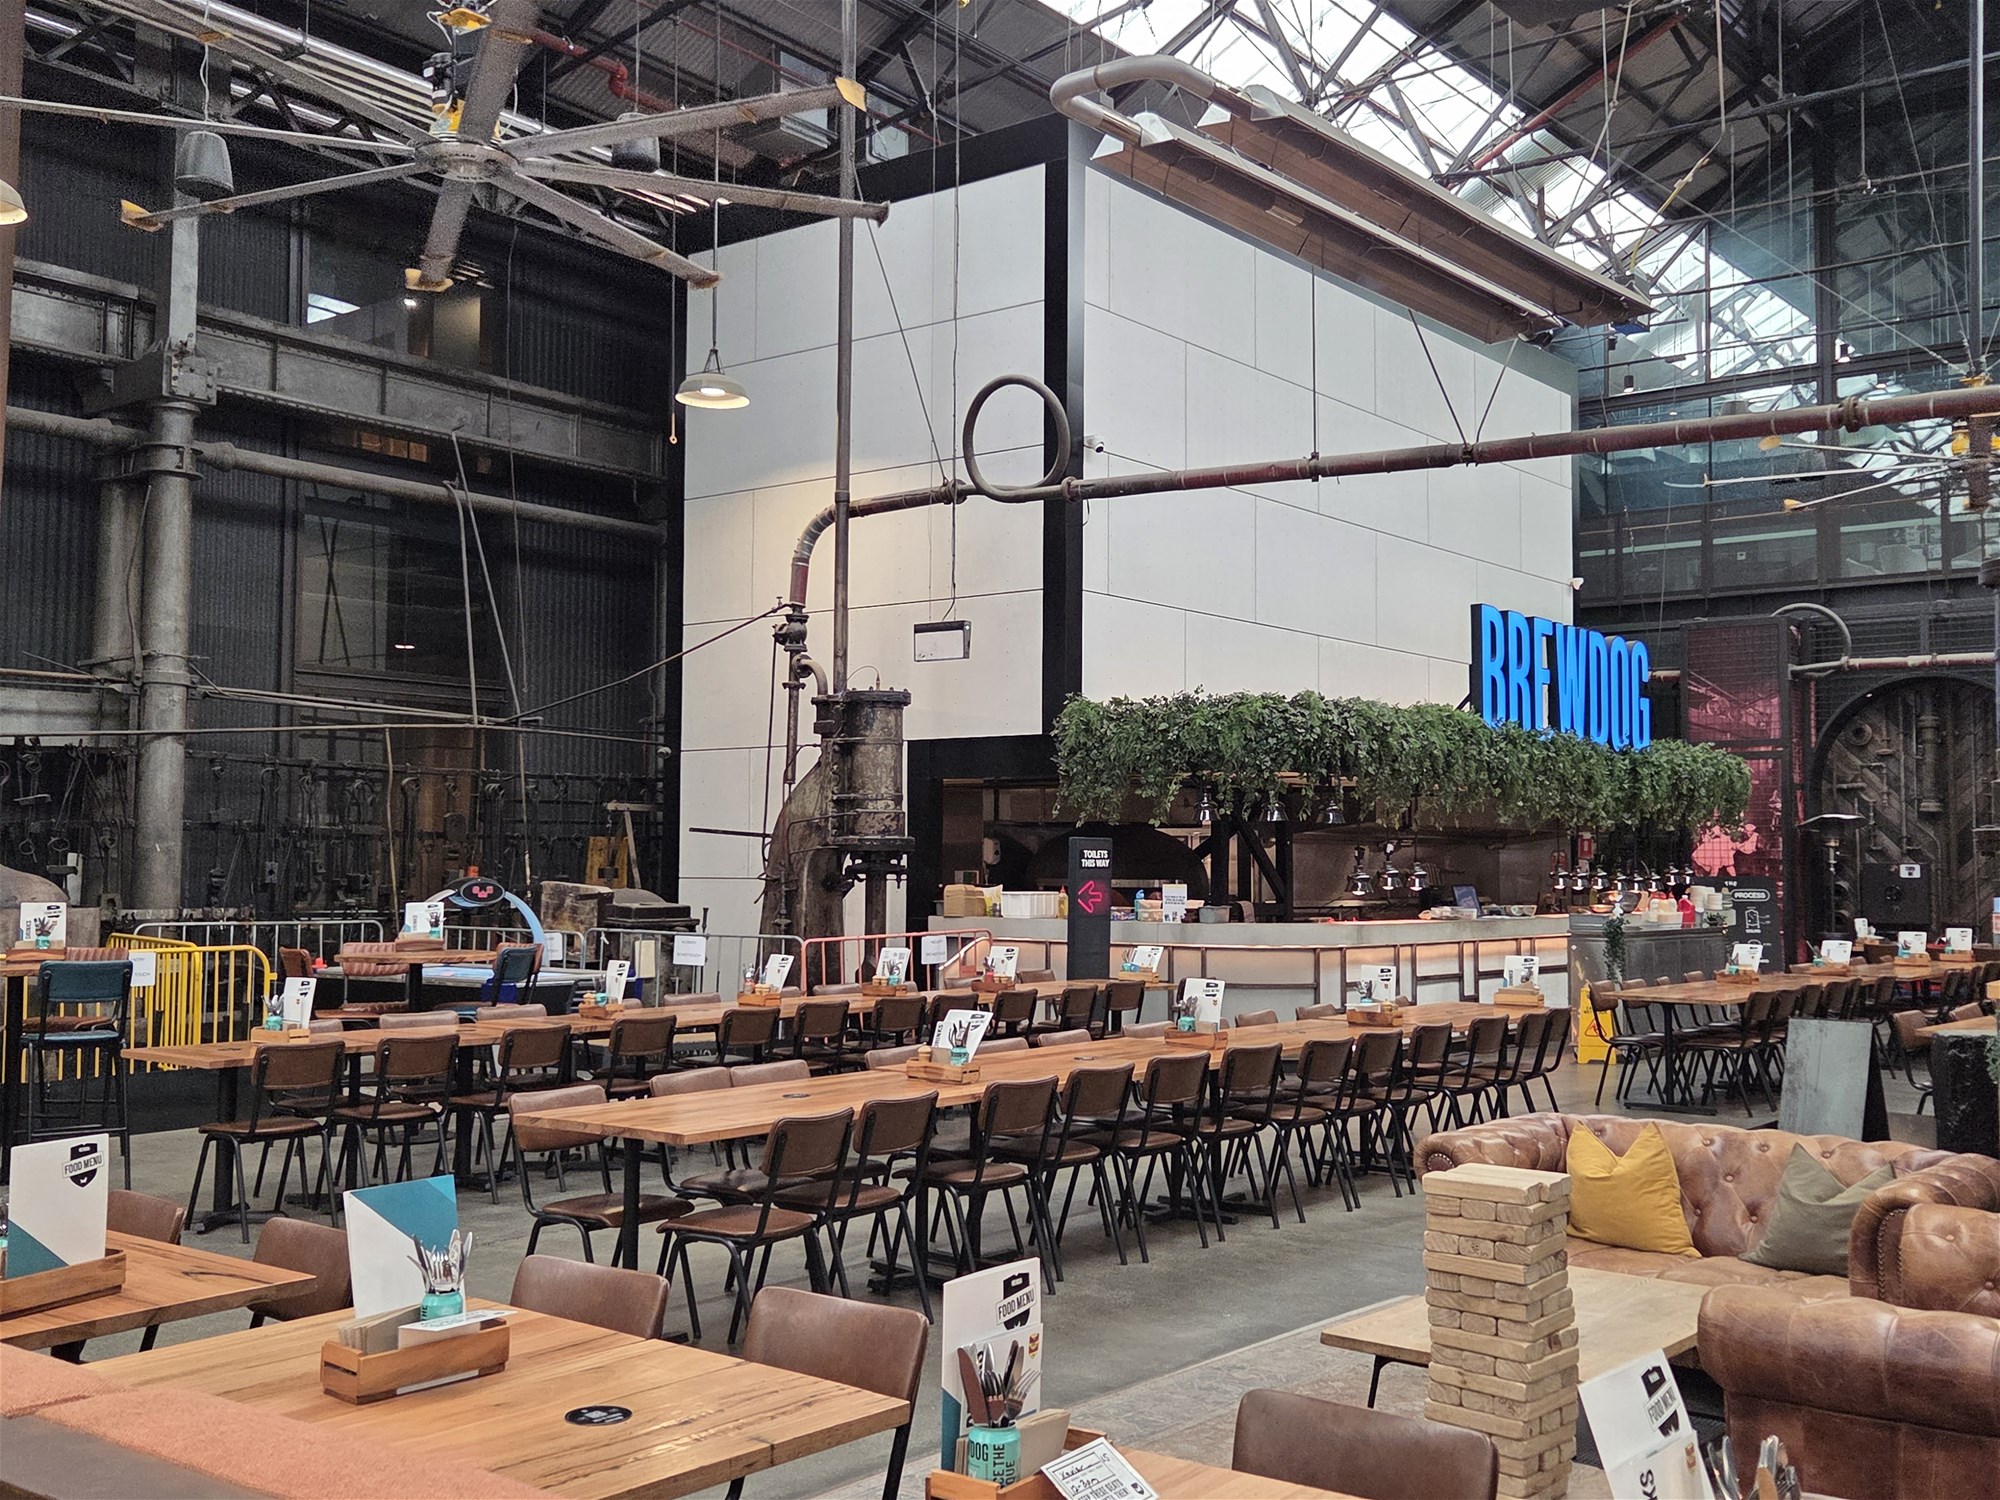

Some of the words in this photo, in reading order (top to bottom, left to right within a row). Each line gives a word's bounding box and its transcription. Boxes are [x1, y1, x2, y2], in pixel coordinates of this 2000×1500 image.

[1478, 604, 1650, 751] BREWDOG
[1081, 859, 1095, 868] THIS
[1095, 859, 1110, 868] WAY
[1083, 849, 1108, 859] TOILETS
[64, 1161, 83, 1175] FOOD
[83, 1154, 103, 1169] MENU
[998, 1299, 1016, 1320] FOOD
[1016, 1288, 1035, 1310] MENU
[992, 1443, 1006, 1470] THE
